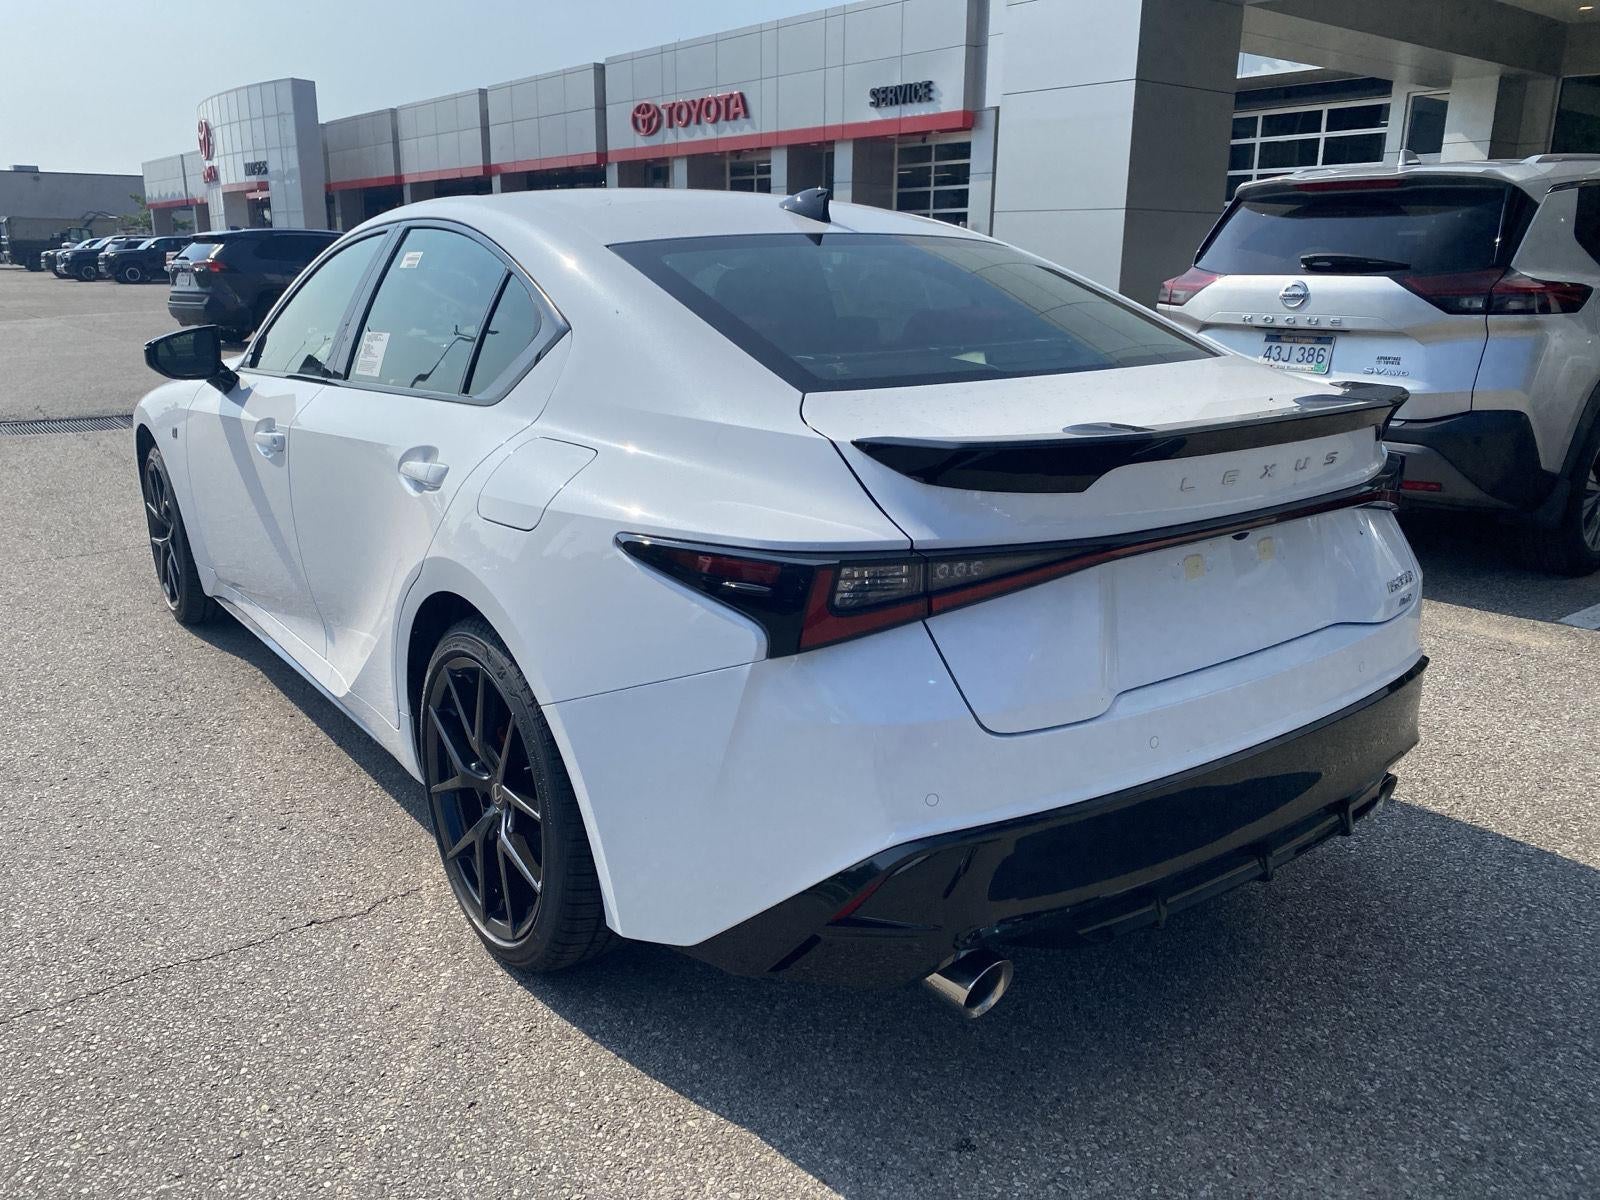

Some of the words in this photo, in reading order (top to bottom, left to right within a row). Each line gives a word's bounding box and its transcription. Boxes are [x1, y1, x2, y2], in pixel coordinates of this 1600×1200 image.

[869, 80, 934, 108] SERVICE
[661, 91, 750, 129] TOYOTA
[1242, 314, 1342, 327] ROGUE
[1263, 345, 1293, 362] 43J
[1296, 346, 1327, 364] 386
[1180, 451, 1339, 492] LEXUS
